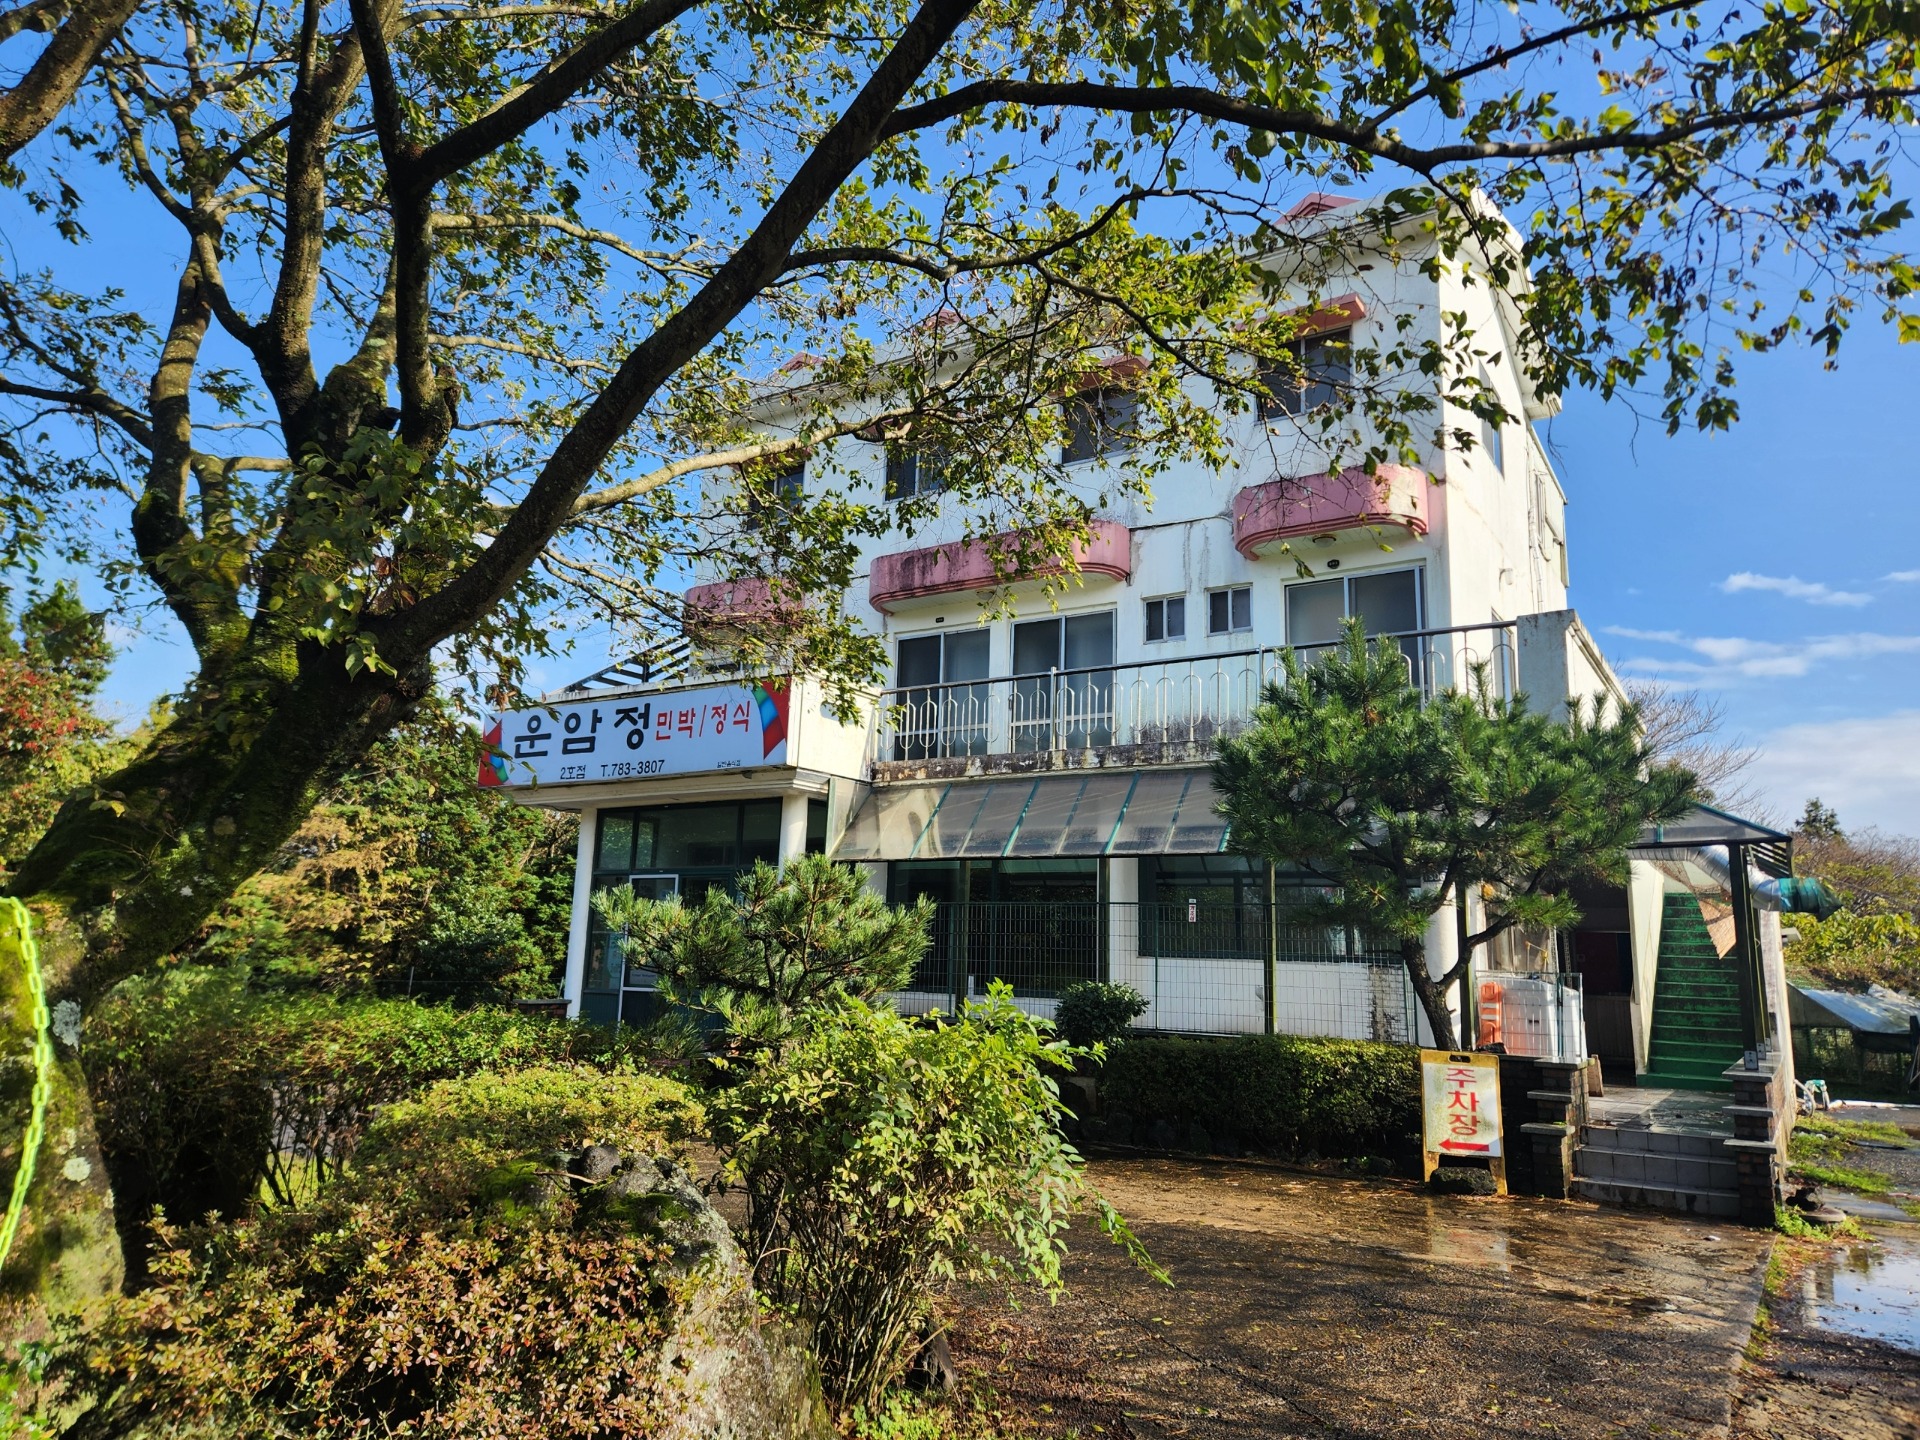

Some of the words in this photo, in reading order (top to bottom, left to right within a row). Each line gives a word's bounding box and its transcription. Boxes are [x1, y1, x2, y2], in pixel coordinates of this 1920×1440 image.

[514, 703, 651, 758] 운암정
[560, 765, 587, 780] 2호점
[600, 759, 666, 778] T.783-3807
[1446, 1067, 1481, 1137] 주차장
